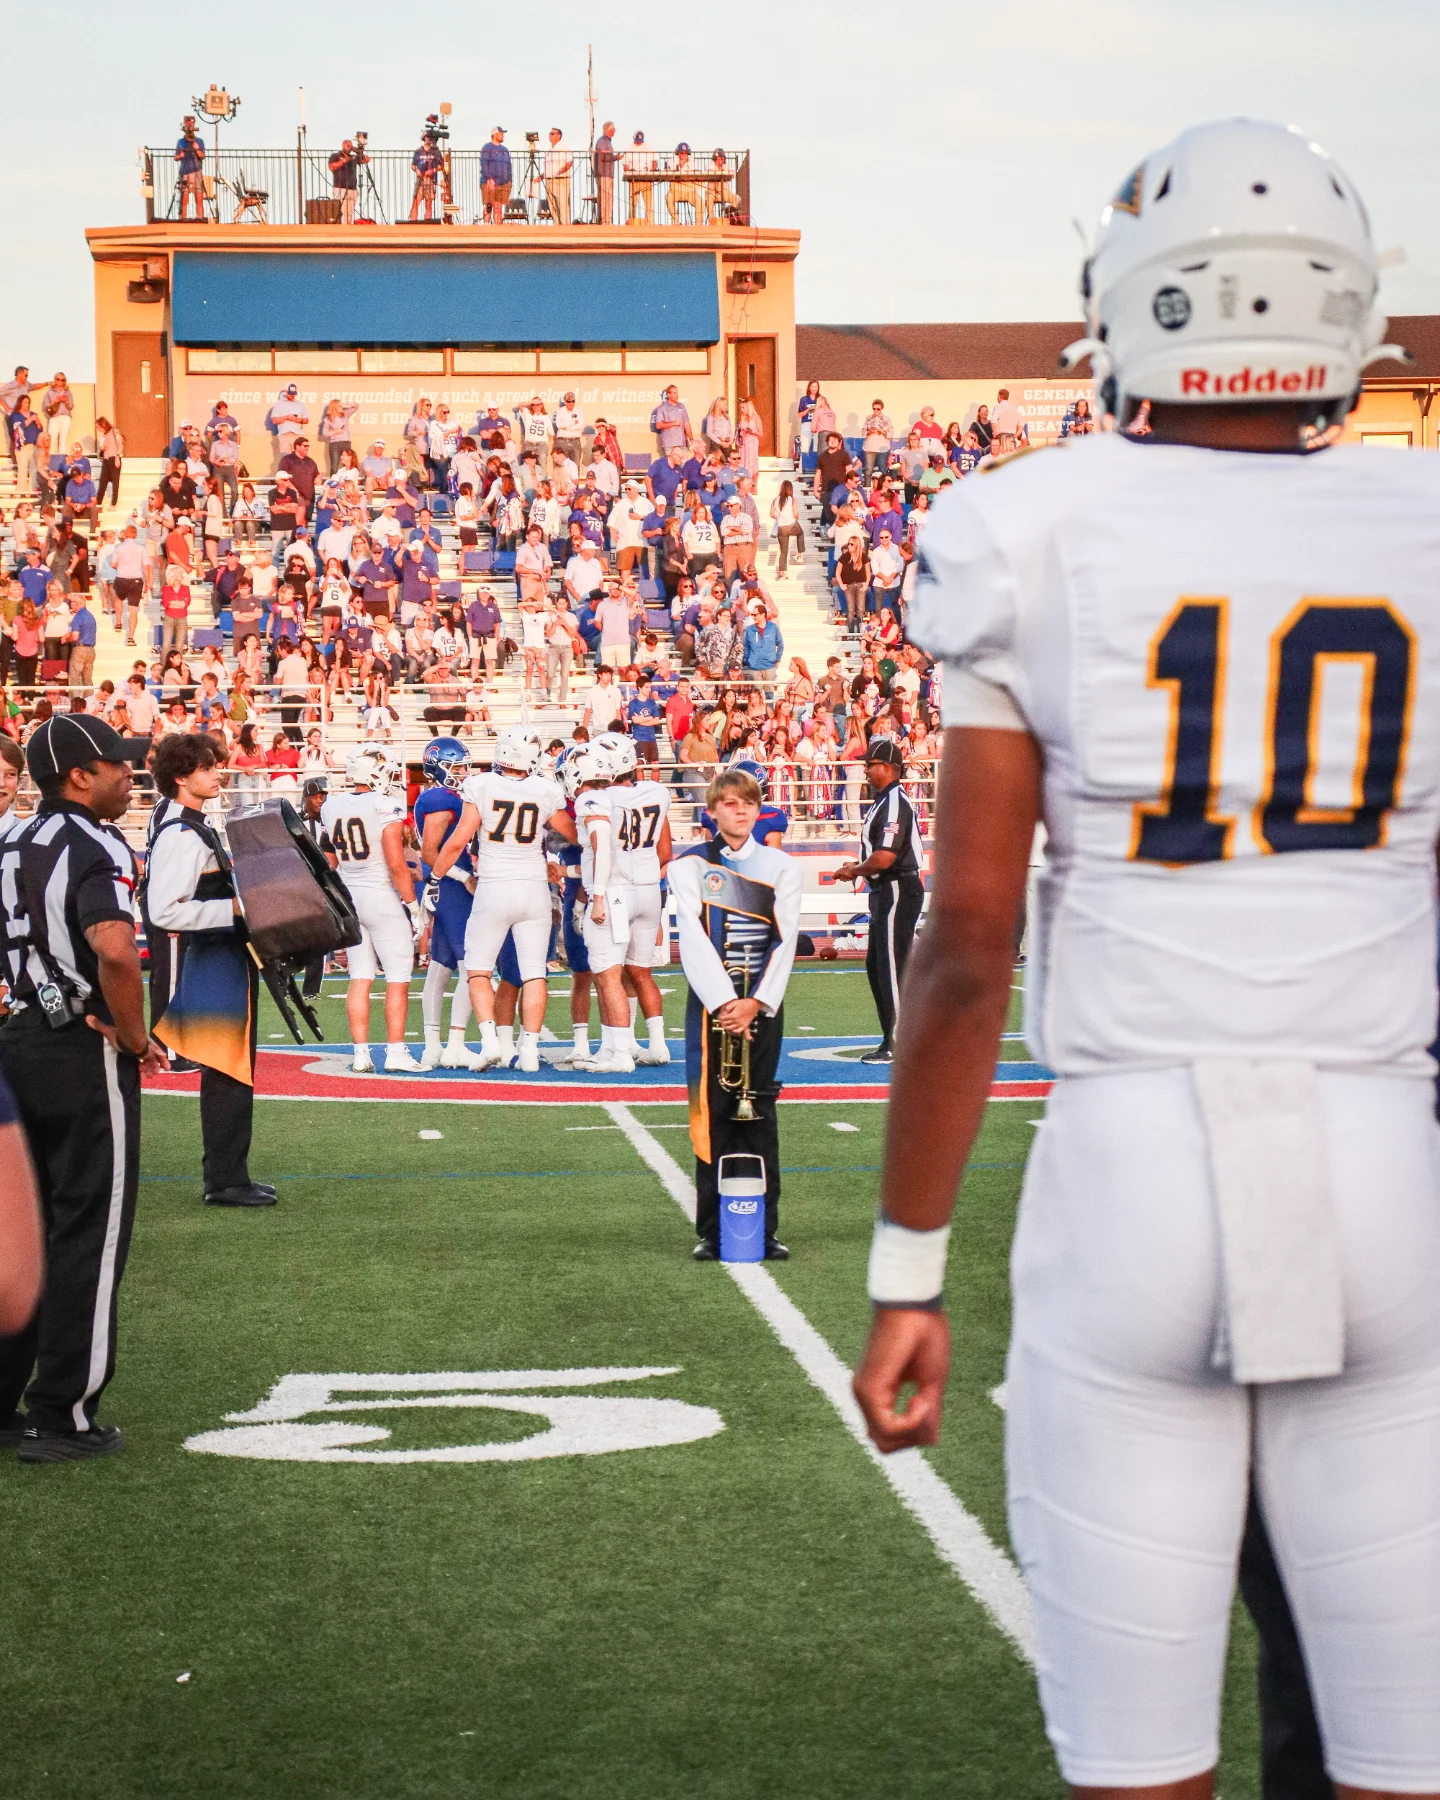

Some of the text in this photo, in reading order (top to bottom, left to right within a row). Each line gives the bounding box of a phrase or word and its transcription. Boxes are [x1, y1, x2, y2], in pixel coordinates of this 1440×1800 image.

[1180, 365, 1327, 395] Riddell
[322, 388, 413, 404] surrounded
[441, 387, 480, 404] such
[484, 391, 492, 404] a
[583, 387, 600, 404] of
[1024, 389, 1095, 400] GENERAL
[360, 413, 379, 425] us
[382, 413, 410, 425] run
[529, 425, 545, 437] 65
[960, 453, 976, 461] TCA
[696, 531, 712, 542] 72
[331, 590, 339, 600] 6
[1126, 595, 1419, 868] 10
[488, 799, 539, 844] 70
[332, 817, 370, 861] 40
[182, 1366, 727, 1462] 5
